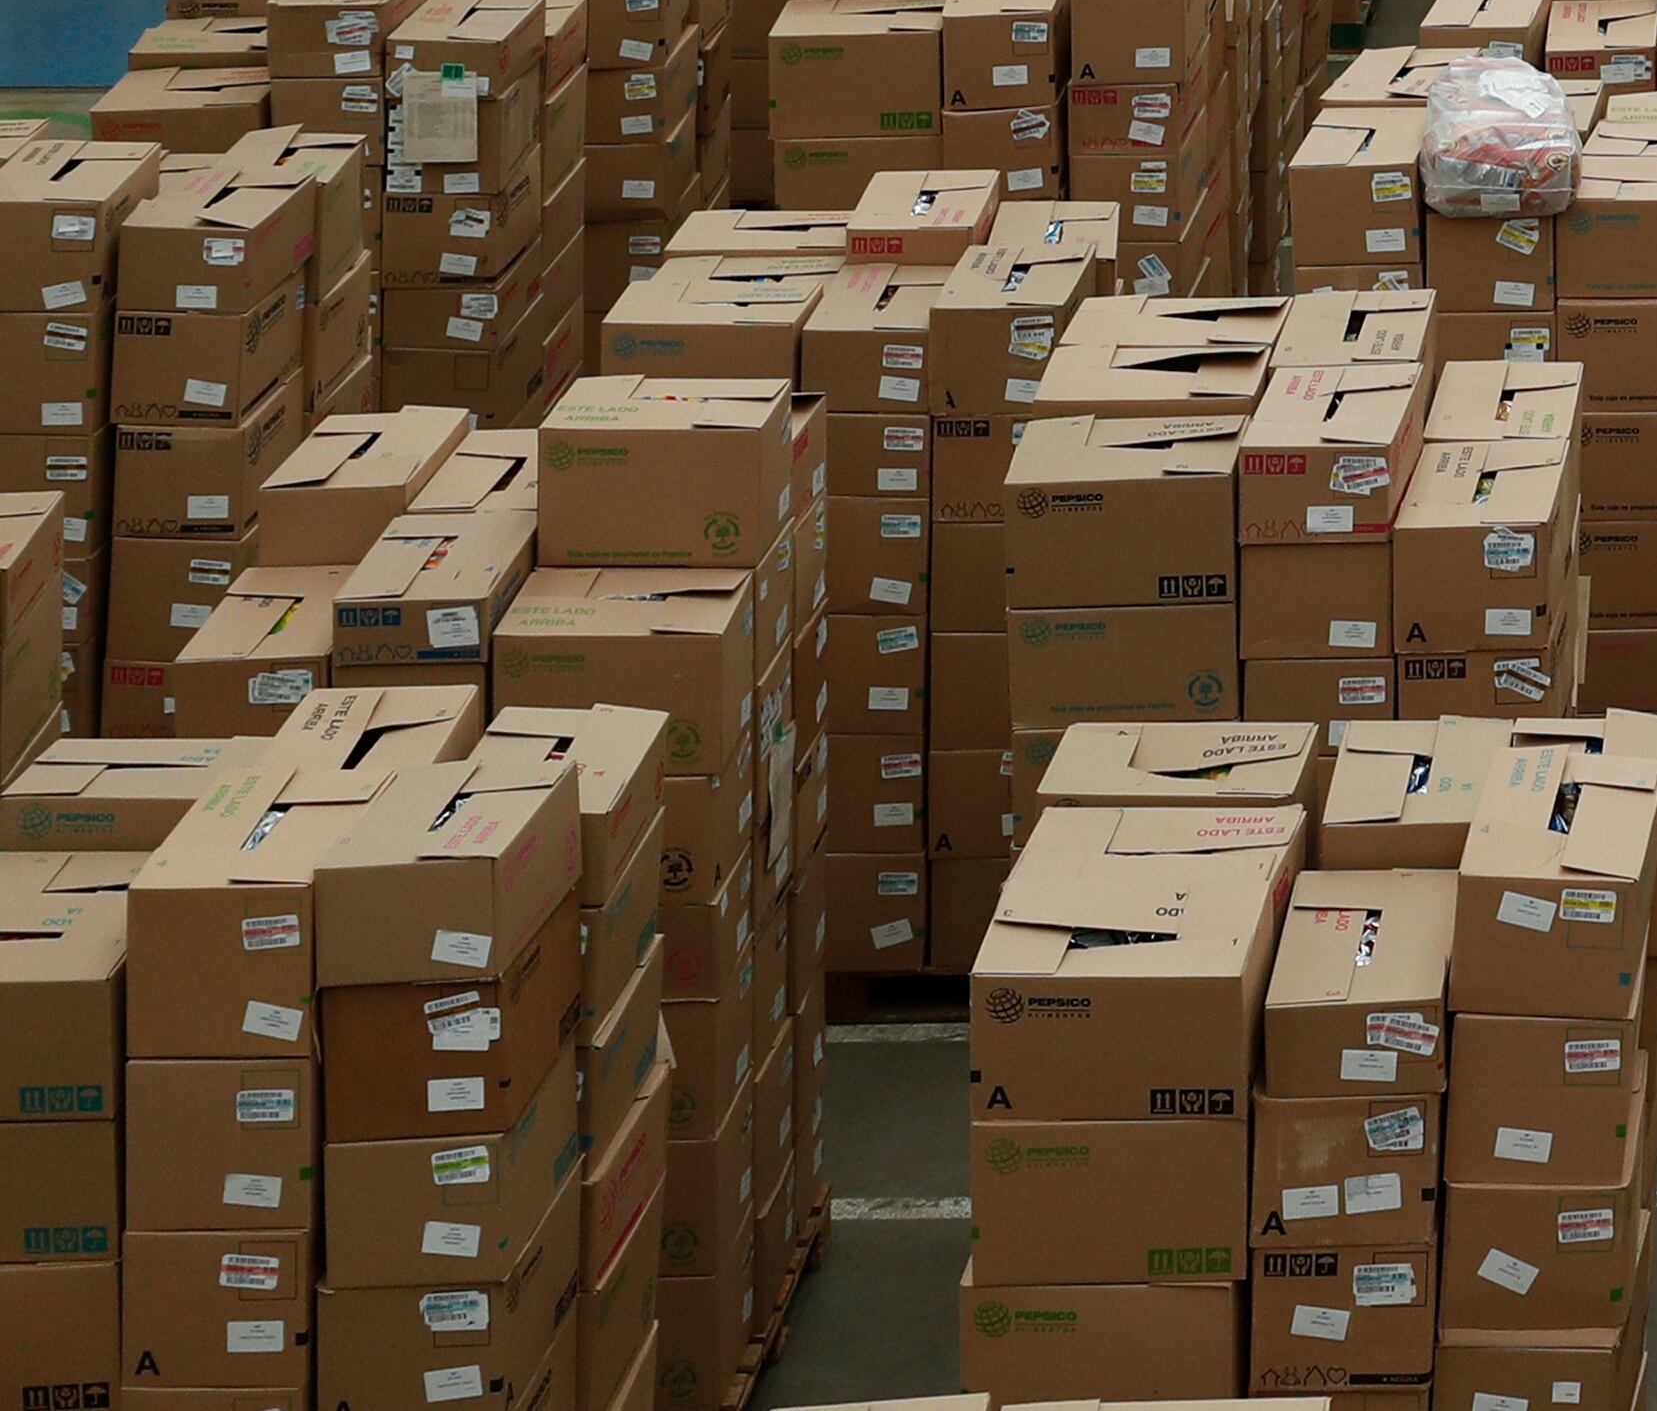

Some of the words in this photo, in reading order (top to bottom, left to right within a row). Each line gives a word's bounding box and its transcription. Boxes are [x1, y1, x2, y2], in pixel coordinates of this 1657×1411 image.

[1080, 64, 1094, 78] A
[951, 92, 966, 105] A
[1596, 427, 1639, 435] PEPSICO
[1459, 446, 1473, 461] ESTE
[1436, 452, 1451, 472] ARRIBA
[1454, 462, 1468, 478] LADO
[1052, 494, 1103, 503] PEPSICO
[1406, 623, 1427, 643] A
[335, 695, 358, 717] ESTE
[302, 703, 328, 730] ARRIBA
[321, 719, 344, 740] LADO
[1221, 734, 1279, 744] ARRIBA
[1202, 746, 1244, 758] LADO
[1248, 743, 1287, 753] ESTE
[1216, 816, 1275, 824] ARRIBA
[1197, 828, 1240, 836] LADO
[1246, 827, 1286, 835] ESTE
[1028, 998, 1091, 1007] PEPSICO
[987, 1087, 1012, 1109] A
[1261, 1212, 1285, 1235] A
[136, 1352, 159, 1376] A
